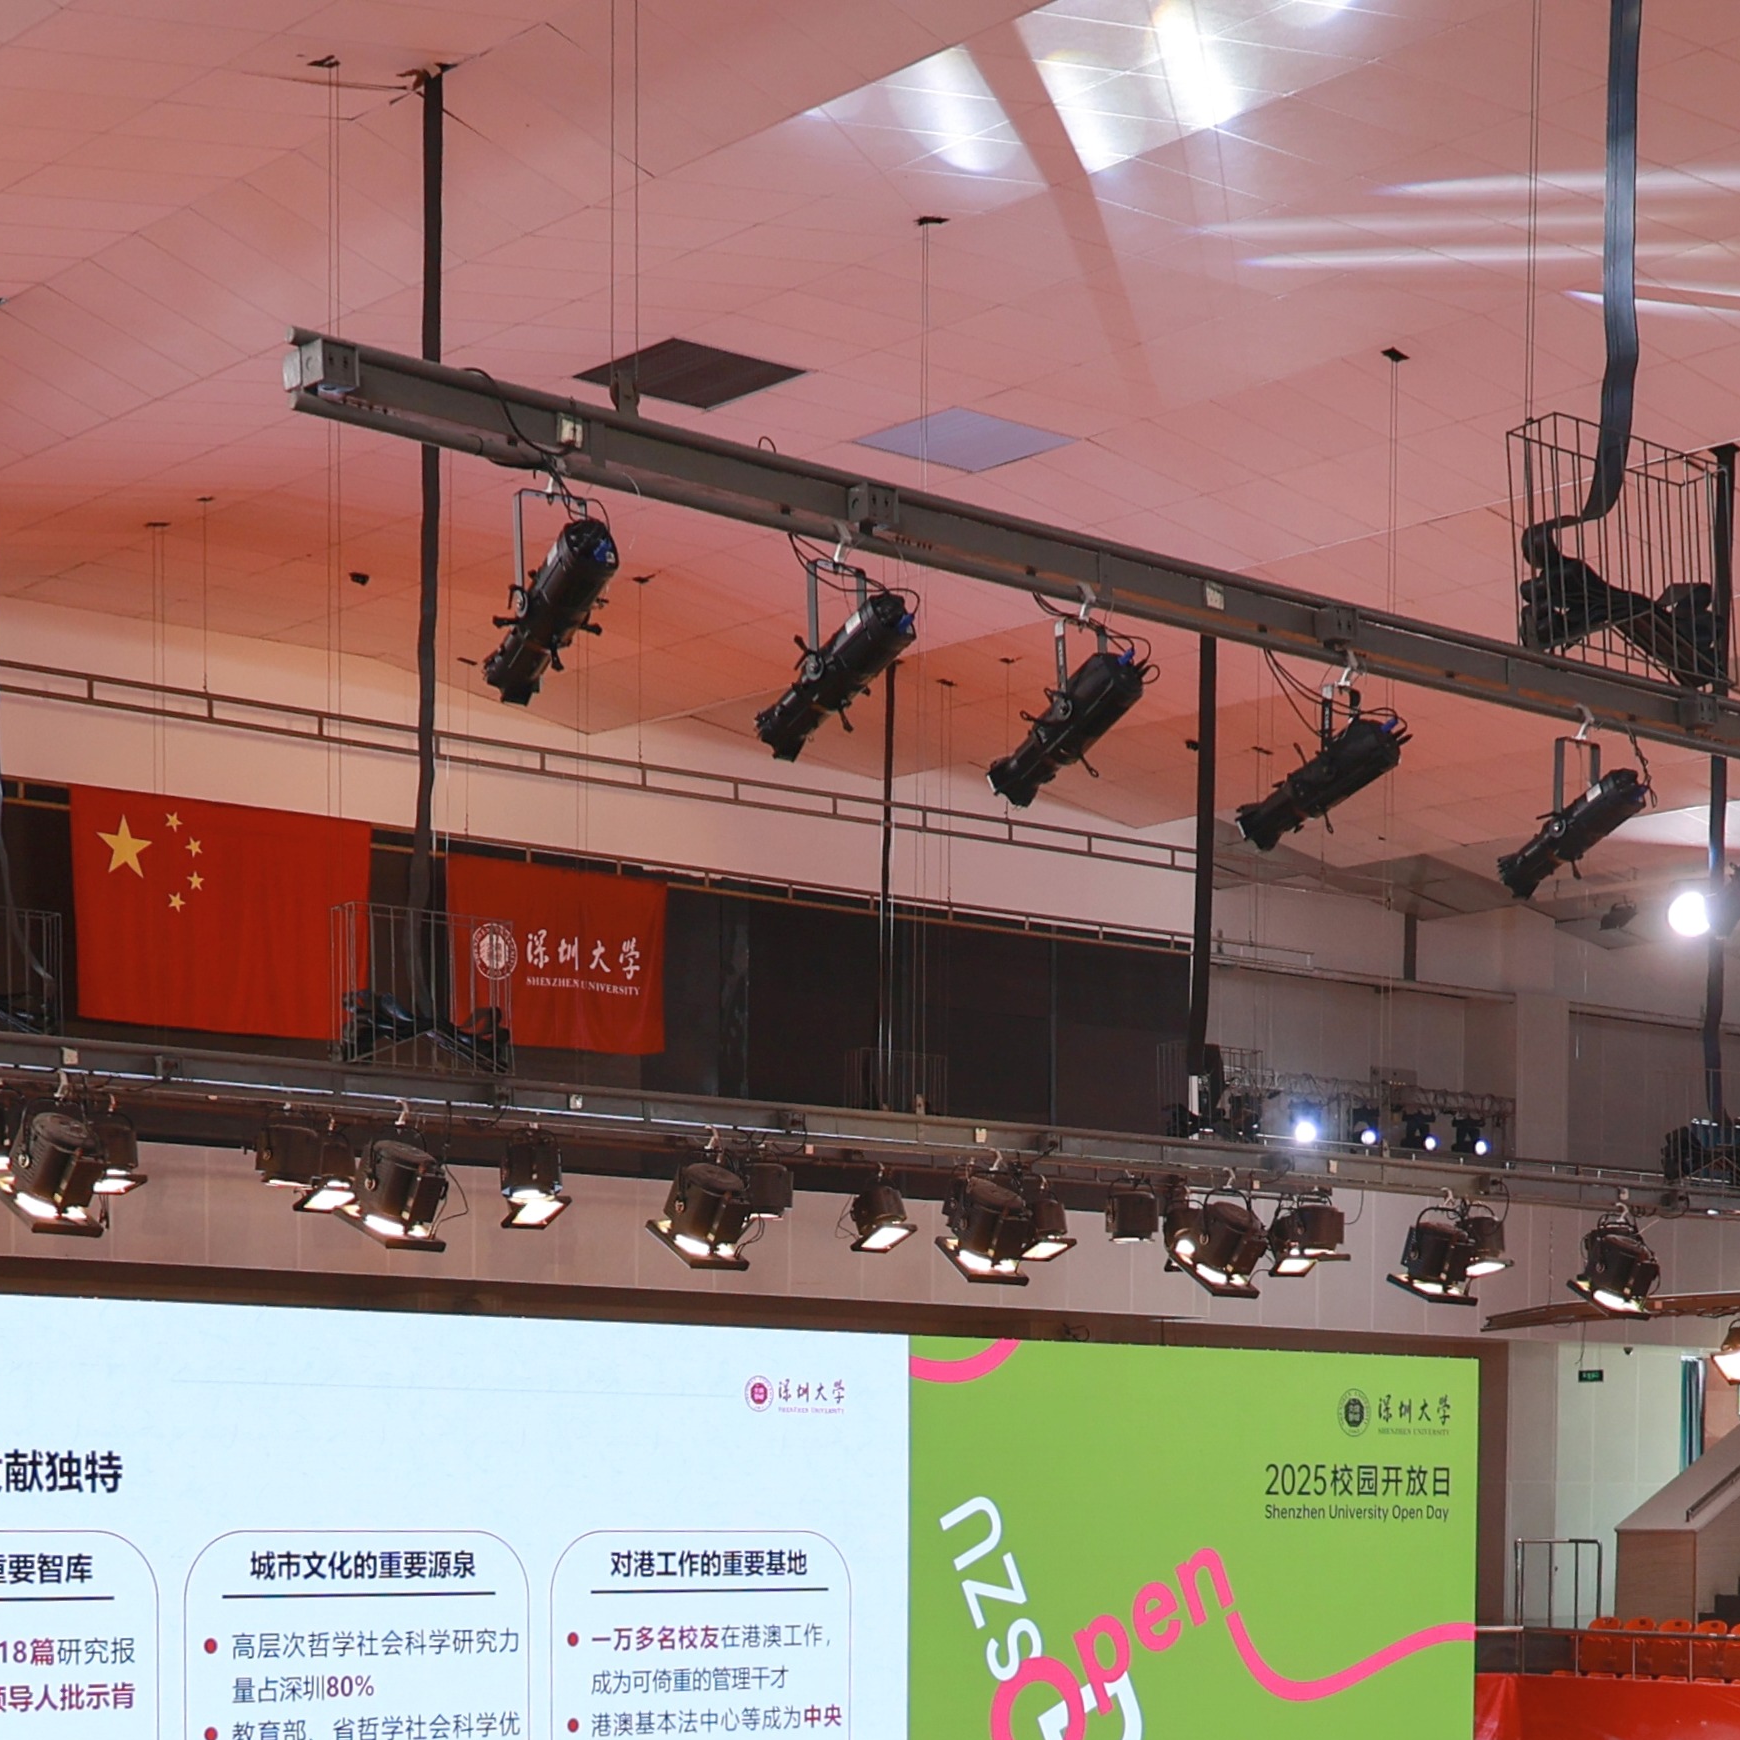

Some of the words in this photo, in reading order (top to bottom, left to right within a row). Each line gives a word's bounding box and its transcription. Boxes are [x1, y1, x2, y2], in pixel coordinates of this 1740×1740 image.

[526, 976, 579, 989] SHENZHEN
[581, 980, 640, 996] UNIVERSITY
[1265, 1463, 1450, 1497] 2025校园开放日
[1264, 1504, 1325, 1520] Shenzhen
[1329, 1504, 1389, 1522] University
[1392, 1505, 1423, 1522] Open
[1426, 1505, 1450, 1523] Day
[249, 1549, 477, 1582] 城市文化的重要源泉
[610, 1548, 807, 1578] 对港工作的重要基地
[231, 1627, 521, 1661] 高层次哲学社会科学研究力
[231, 1673, 375, 1705] 量占深圳80%
[590, 1664, 789, 1697] 成为可倚重的管理干才
[590, 1703, 843, 1738] 港澳基本法中心等成为中央
